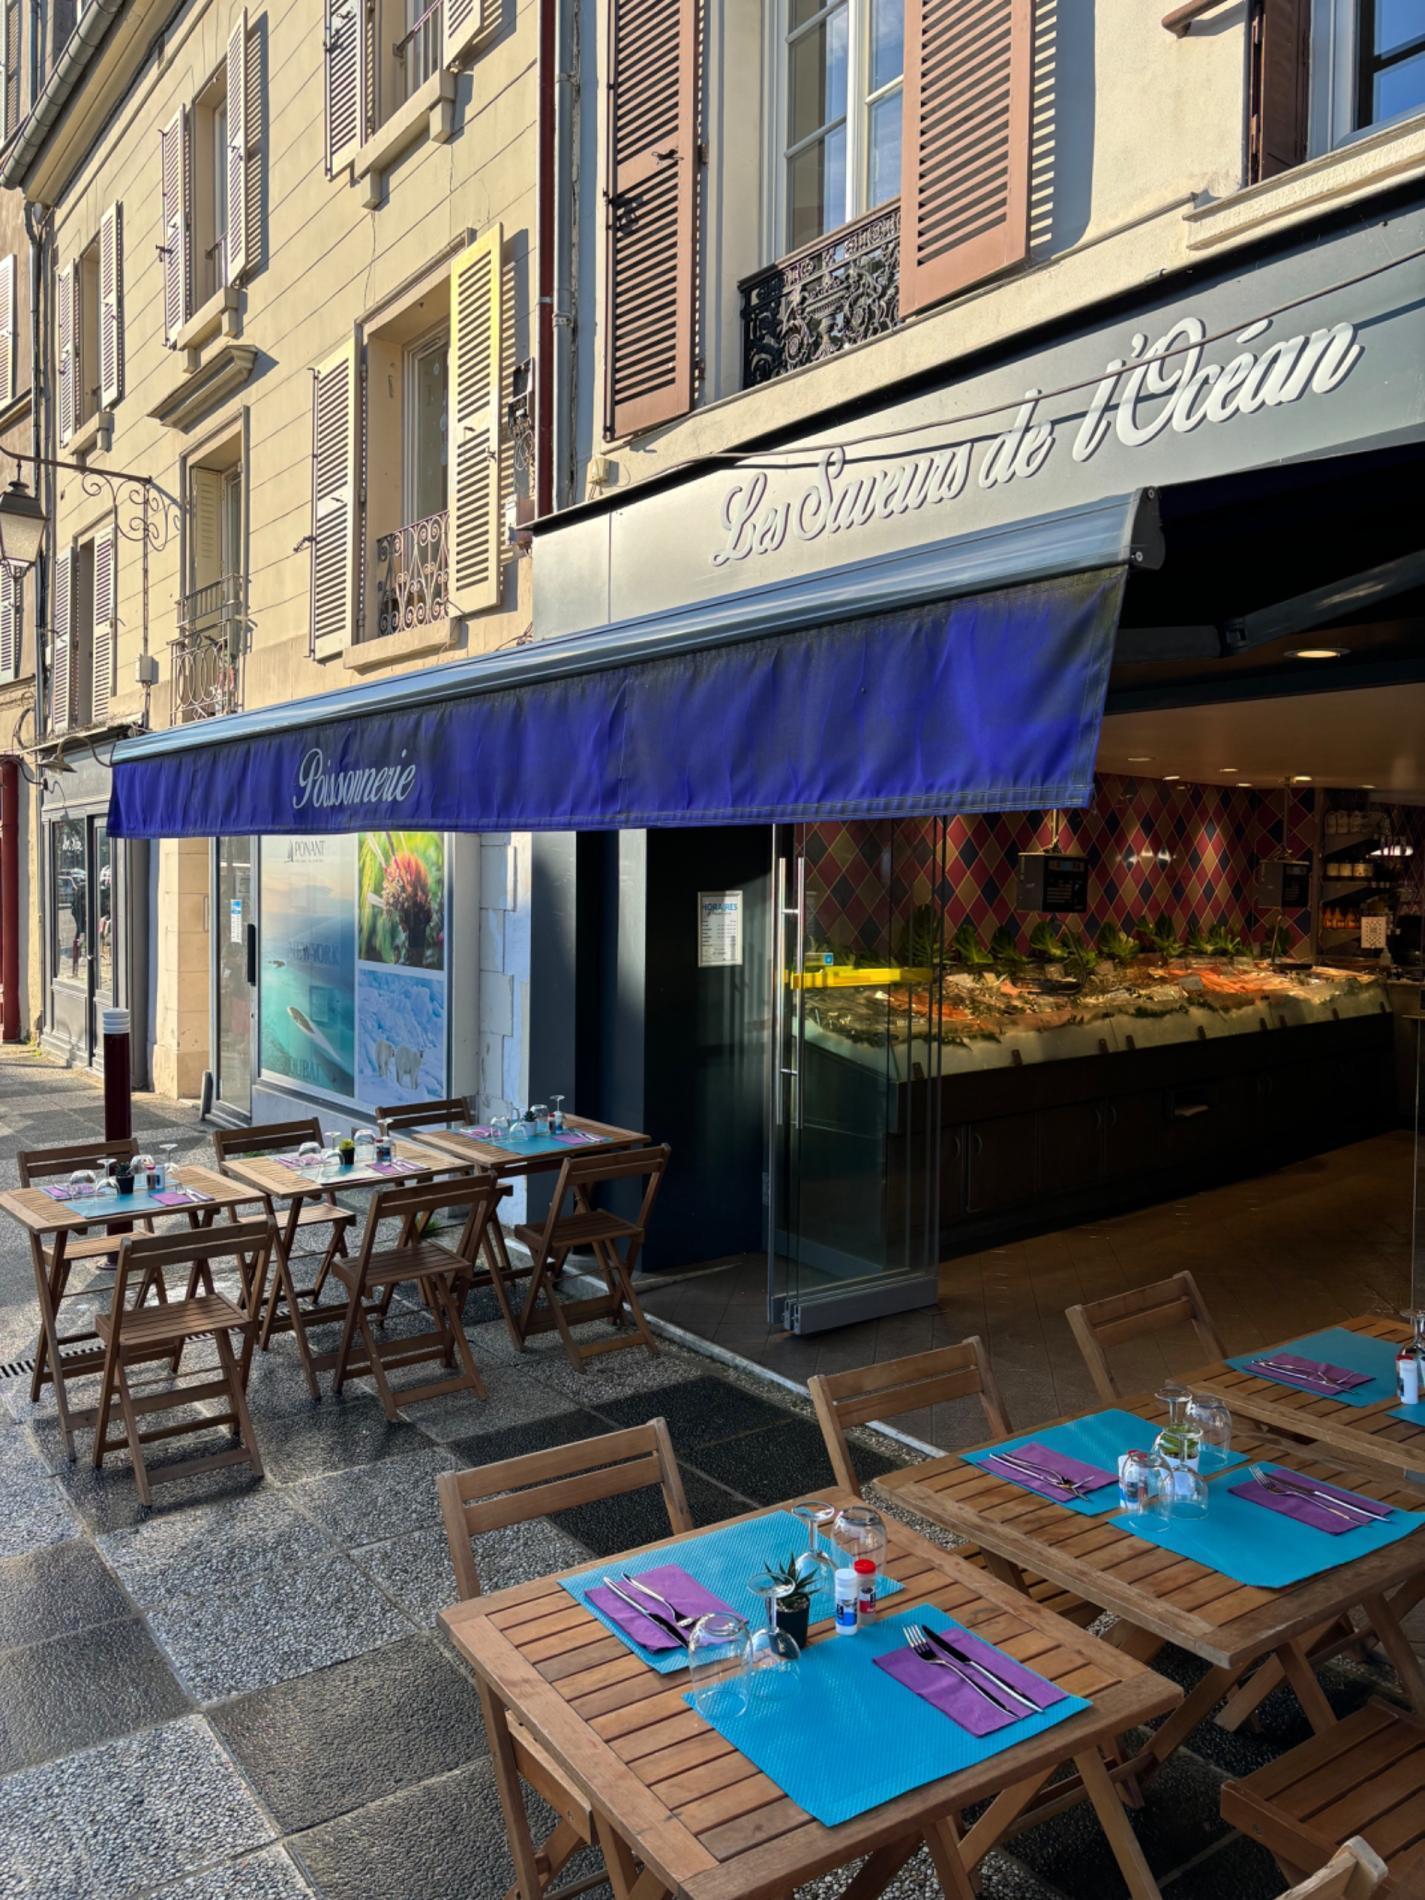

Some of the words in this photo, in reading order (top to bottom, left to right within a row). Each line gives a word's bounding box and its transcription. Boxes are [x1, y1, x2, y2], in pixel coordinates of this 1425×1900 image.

[712, 471, 790, 567] Les
[793, 446, 973, 540] Saveurs
[978, 388, 1055, 488] de
[1072, 317, 1364, 462] l'Océan
[292, 748, 416, 809] Poissonnerie
